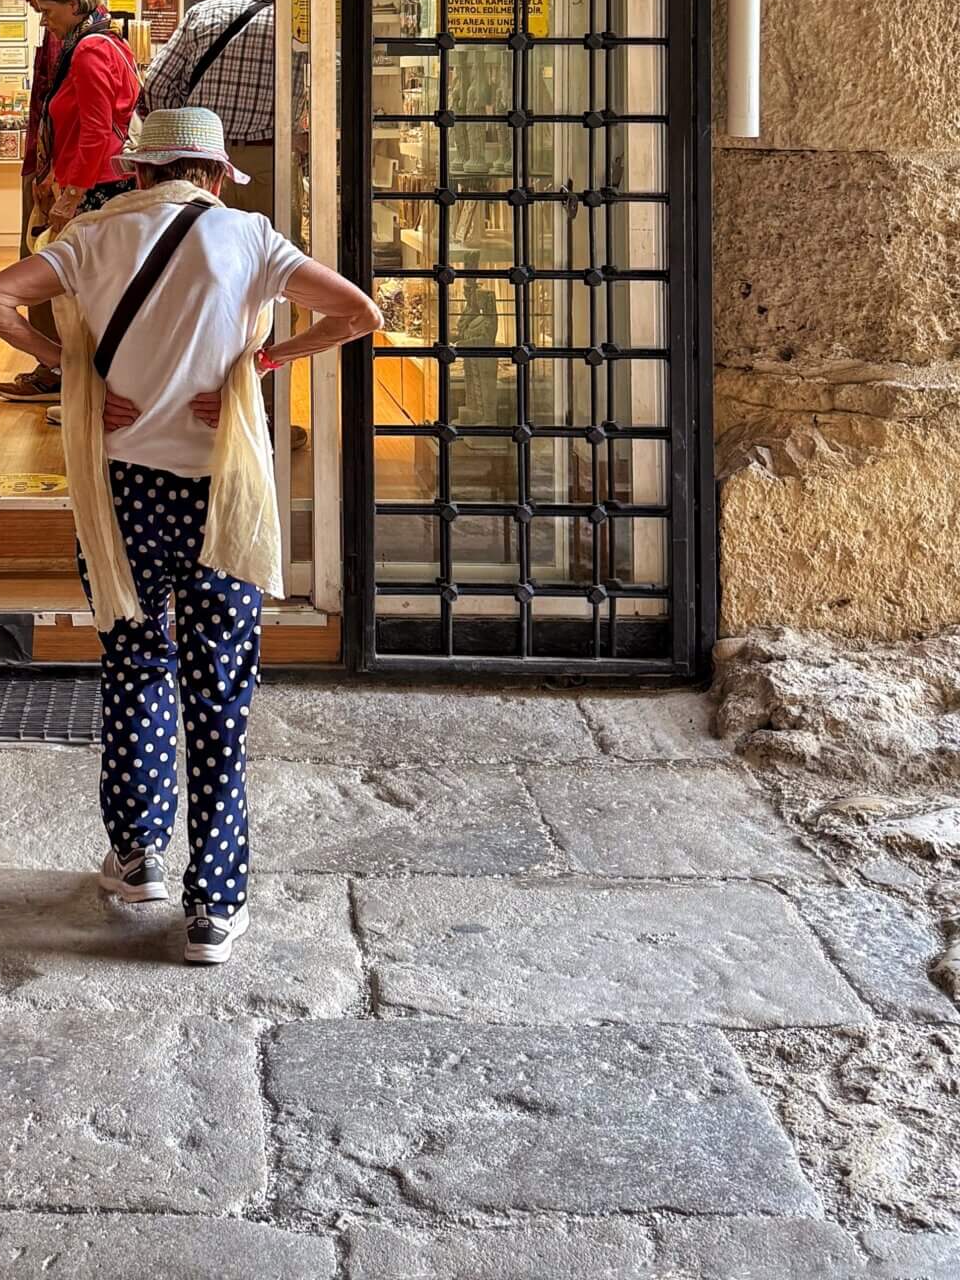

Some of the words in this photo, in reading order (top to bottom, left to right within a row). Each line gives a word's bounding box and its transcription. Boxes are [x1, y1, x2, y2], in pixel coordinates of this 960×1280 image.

[447, 6, 481, 14] ONTROL
[447, 18, 461, 26] HIS
[463, 18, 485, 26] AREA
[487, 18, 495, 26] IS
[497, 18, 523, 26] UND
